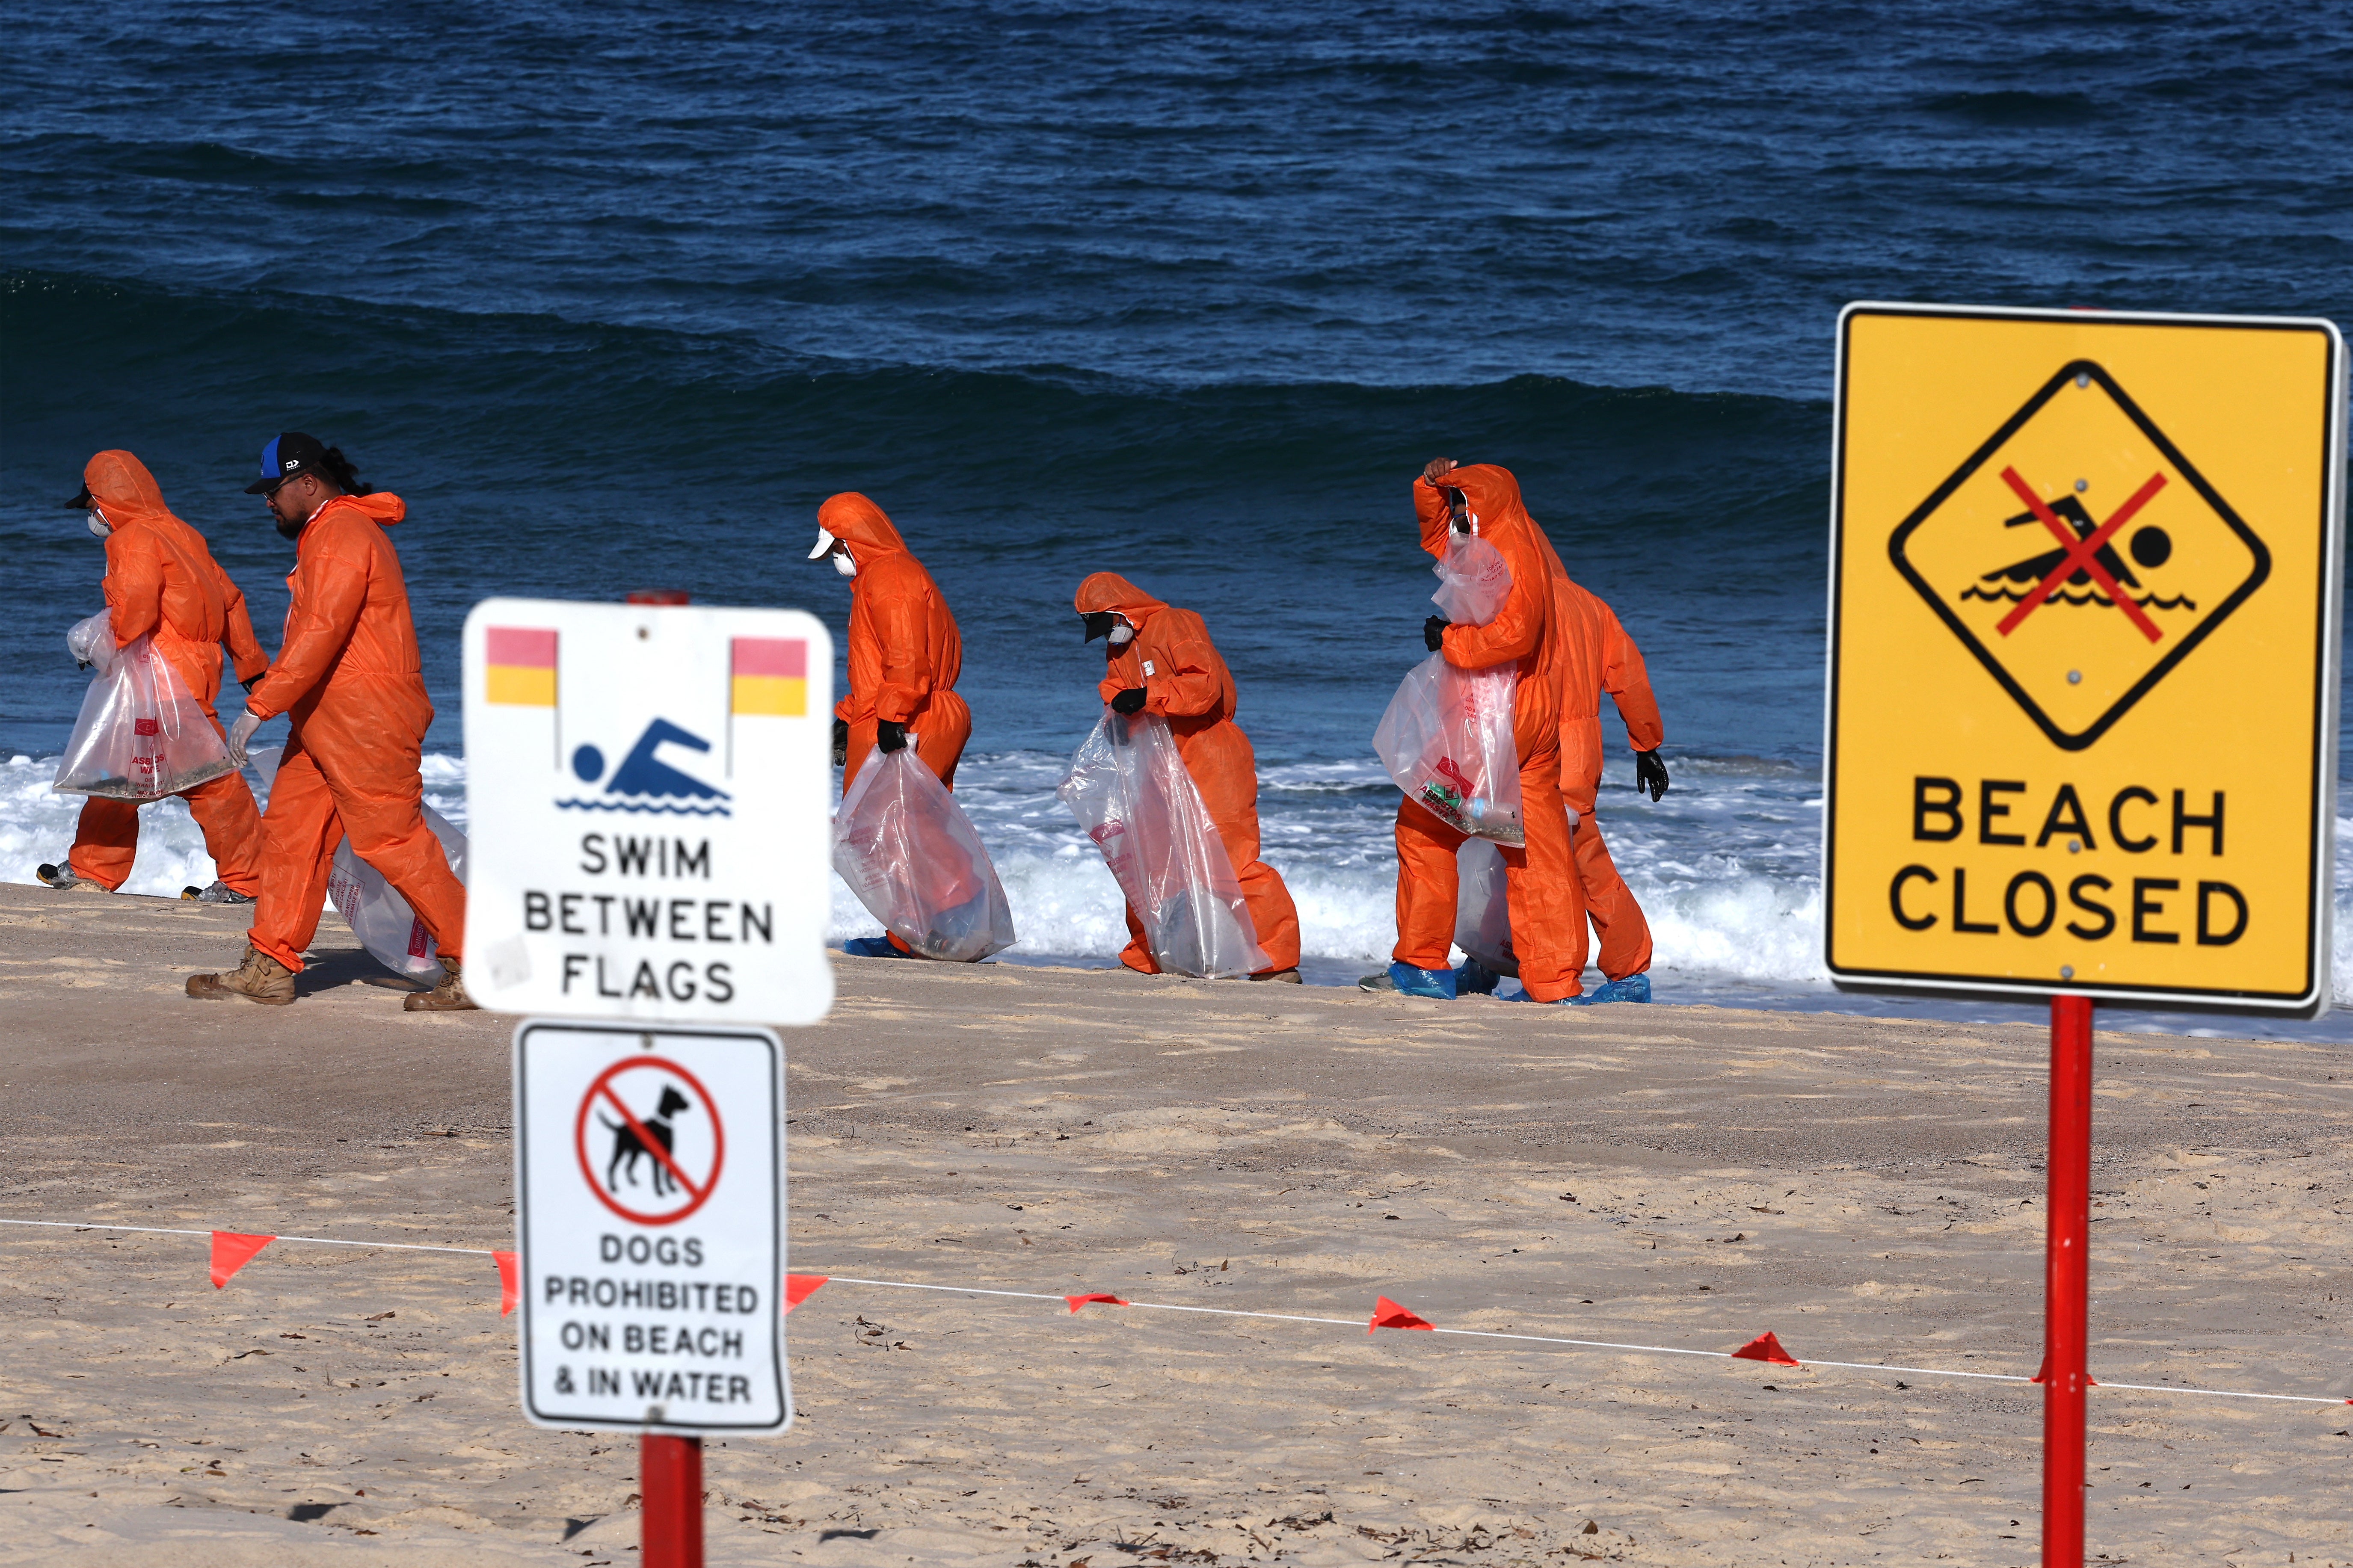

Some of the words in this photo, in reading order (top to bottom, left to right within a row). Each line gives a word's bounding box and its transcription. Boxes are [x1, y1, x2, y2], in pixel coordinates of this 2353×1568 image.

[1420, 785, 1462, 821] ASBESTOS
[1421, 797, 1450, 819] WASTE
[1913, 776, 2225, 857] BEACH
[580, 832, 711, 879] SWIM
[340, 878, 348, 901] CANCER!
[1889, 864, 2249, 947] CLOSED
[344, 909, 349, 917] DO
[524, 891, 773, 943] BETWEEN
[414, 924, 424, 949] DANGER
[563, 953, 734, 1004] FLAGS
[600, 1234, 703, 1267] DOGS
[545, 1275, 758, 1315] PROHIBITED
[561, 1321, 610, 1350] ON
[624, 1324, 743, 1358] BEACH
[555, 1366, 576, 1395] &
[589, 1369, 620, 1396] IN
[633, 1371, 751, 1403] WATER
